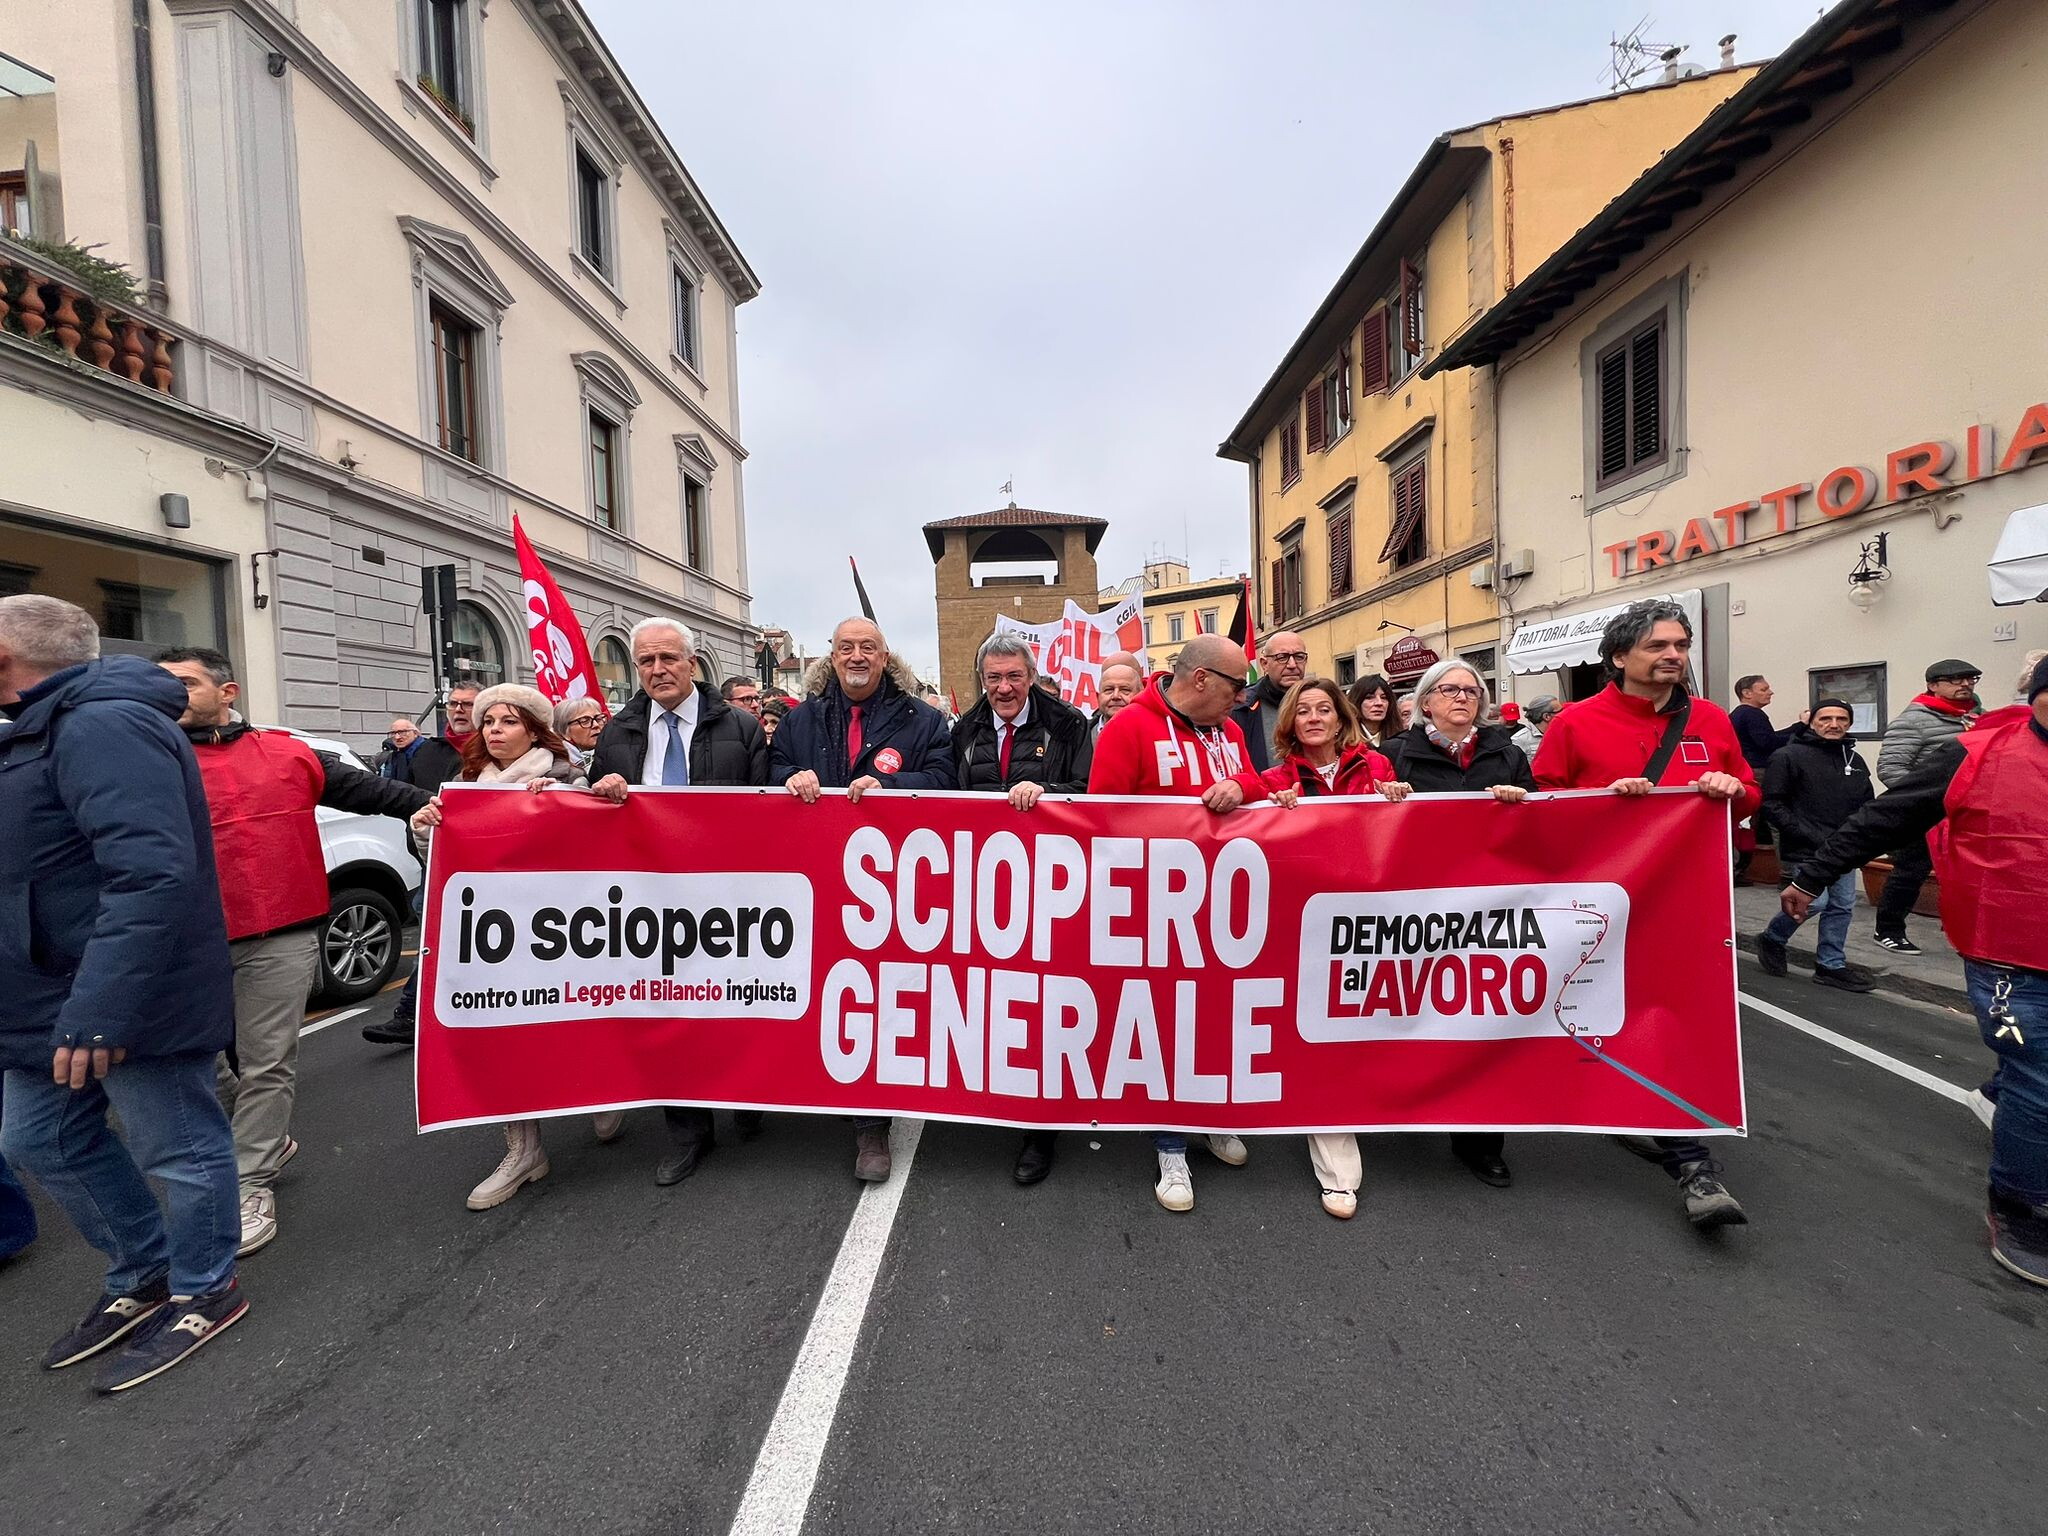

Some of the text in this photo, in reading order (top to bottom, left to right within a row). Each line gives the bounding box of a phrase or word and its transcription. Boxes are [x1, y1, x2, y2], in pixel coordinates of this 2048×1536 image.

[1603, 402, 2048, 578] TRATTORIA
[1116, 602, 1137, 626] CGIL
[1515, 623, 1570, 648] TRATTORIA
[1387, 654, 1436, 671] FIASCHETTERIA
[842, 826, 1270, 969] SCIOPERO
[459, 885, 794, 976] io sciopero
[1330, 908, 1547, 955] DEMOCRAZIA
[451, 978, 797, 1010] contro una Legge di Bilancio ingiusta
[1327, 953, 1548, 1018] al LAVORO
[820, 959, 1285, 1104] GENERALE
